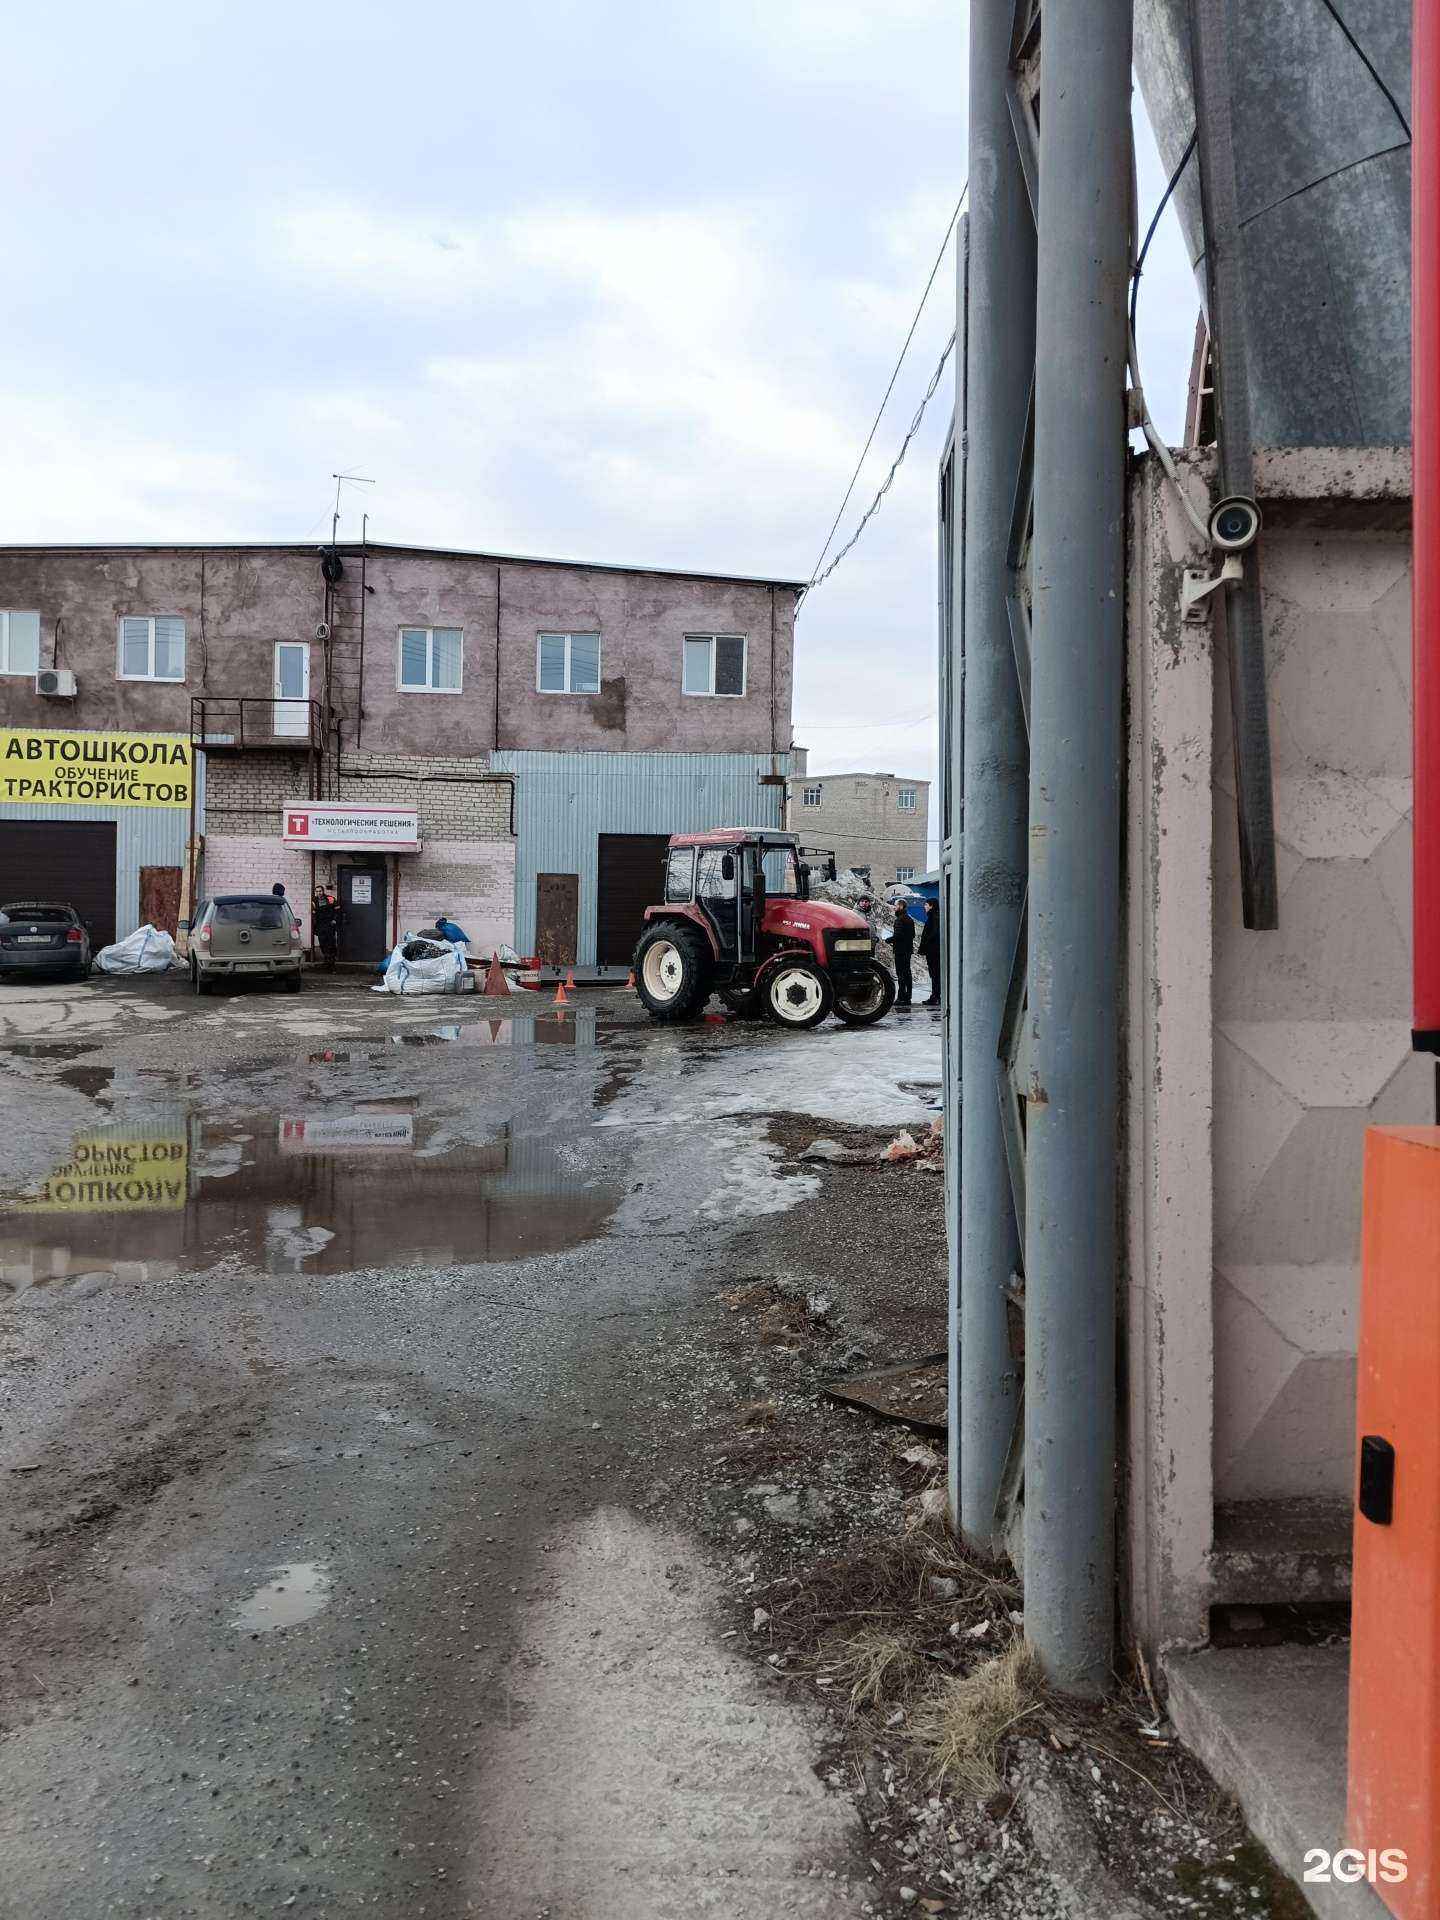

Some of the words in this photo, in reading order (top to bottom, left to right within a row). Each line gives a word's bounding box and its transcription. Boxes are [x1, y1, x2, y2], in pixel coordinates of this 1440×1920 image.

[5, 738, 188, 765] АВТОШКОЛА
[54, 766, 139, 781] ОБУЧЕНИЕ
[4, 778, 188, 801] ТРАКТОРИСТОВ
